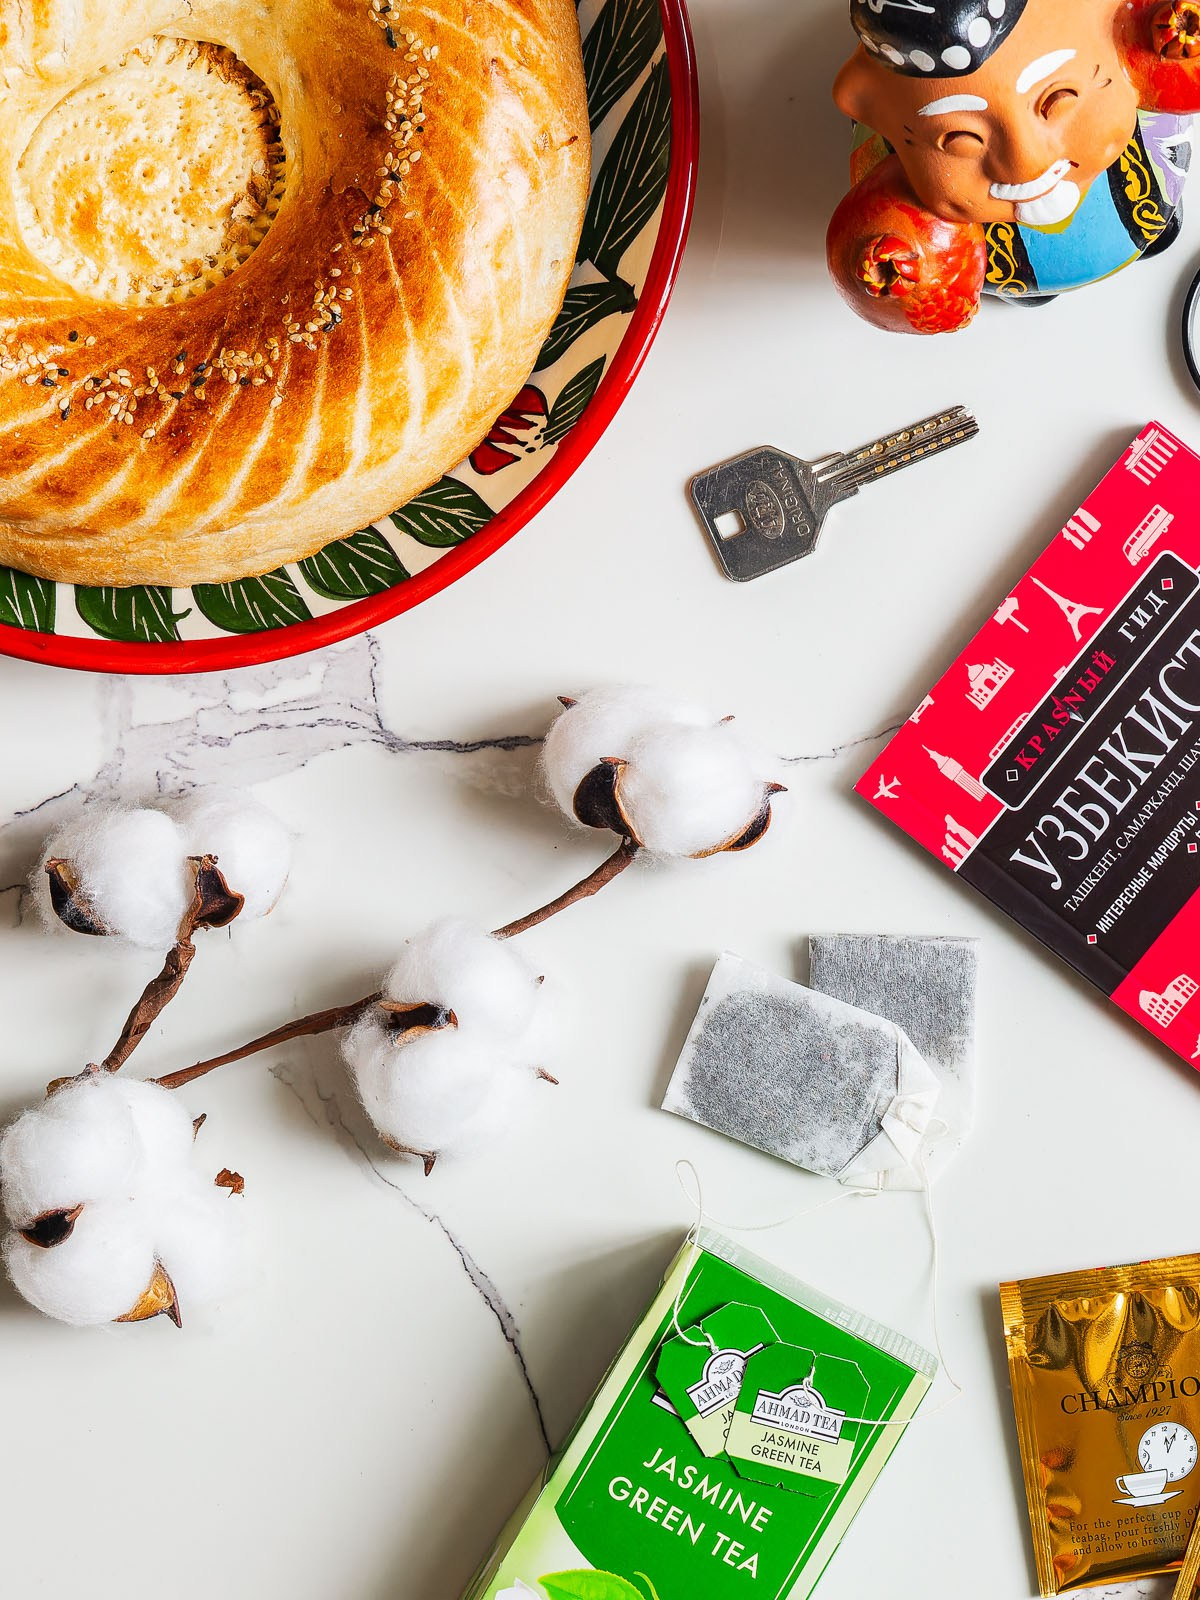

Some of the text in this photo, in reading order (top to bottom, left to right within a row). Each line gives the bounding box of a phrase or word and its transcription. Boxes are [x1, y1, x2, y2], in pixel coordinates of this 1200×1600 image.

[1118, 590, 1169, 643] ГИД
[1063, 848, 1122, 912] ТАШКЕНТ,
[1115, 770, 1186, 850] САМАРКАНД,
[1095, 866, 1154, 934] ИНТЕРЕСНЫЕ
[1146, 811, 1199, 871] МАРШРУТЫ
[757, 1400, 810, 1424] AHMAD
[813, 1413, 839, 1432] TEA
[781, 1422, 810, 1433] LONDON
[1117, 1405, 1172, 1422] Since 1927
[761, 1432, 820, 1456] JASMINE
[751, 1445, 822, 1473] GREEN TEA
[643, 1447, 773, 1533] JASMINE
[608, 1476, 759, 1579] GREEN TEA
[1070, 1521, 1088, 1532] For
[1094, 1518, 1112, 1529] the
[1117, 1512, 1156, 1529] perfect
[1162, 1509, 1182, 1521] cup
[1071, 1532, 1111, 1545] teabag,
[1114, 1528, 1139, 1541] pour
[1144, 1520, 1180, 1535] freshly
[1073, 1533, 1186, 1556] and allow to brew for
